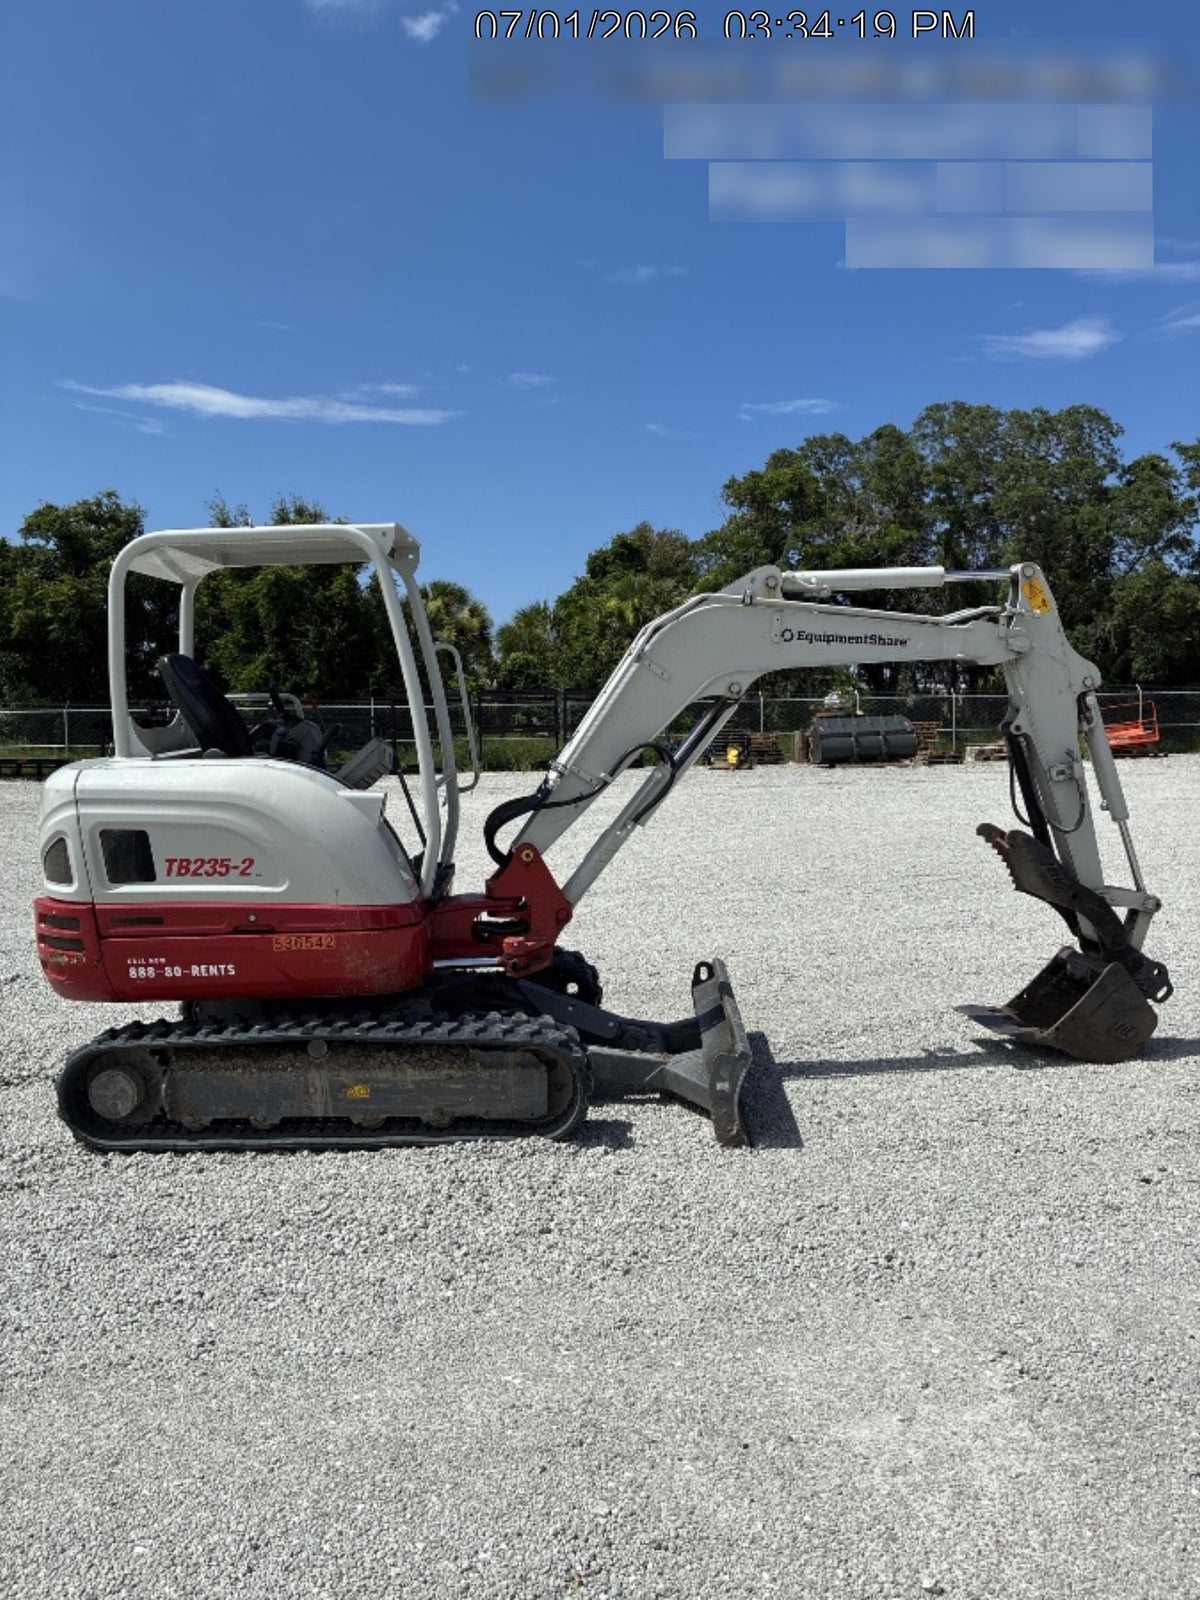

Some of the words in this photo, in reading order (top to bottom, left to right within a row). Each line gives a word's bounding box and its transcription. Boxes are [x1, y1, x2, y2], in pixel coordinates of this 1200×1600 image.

[796, 630, 908, 646] EquipmentShare
[164, 857, 255, 877] TB235-2
[129, 965, 236, 978] 888-80-RENTS
